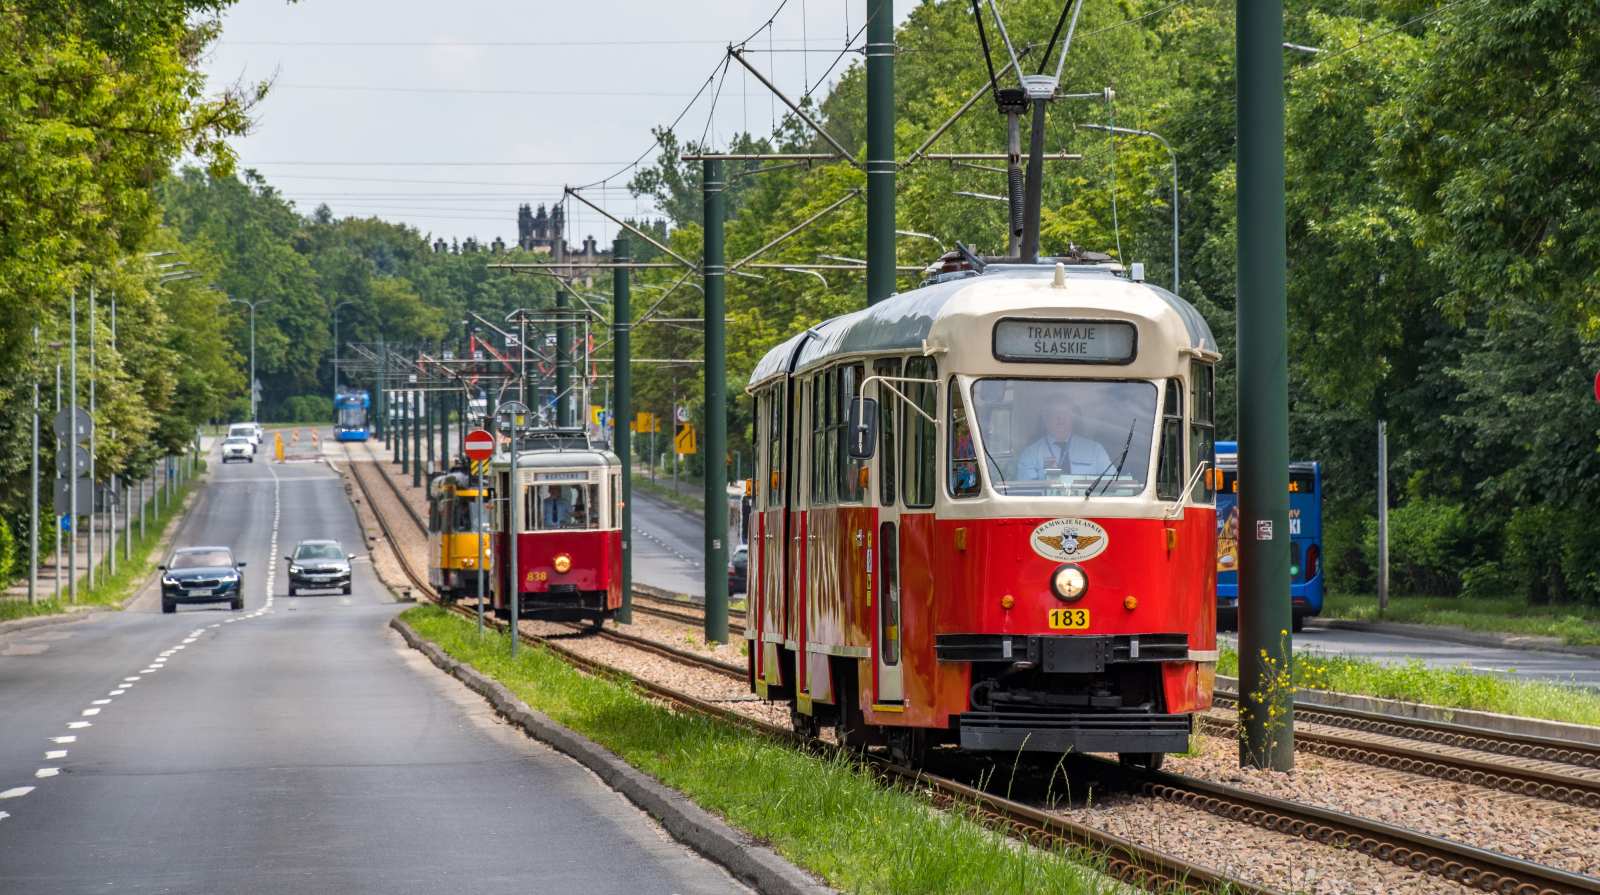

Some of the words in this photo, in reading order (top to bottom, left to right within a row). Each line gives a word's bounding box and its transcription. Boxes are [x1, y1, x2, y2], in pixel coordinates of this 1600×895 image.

[1027, 326, 1096, 340] TRAMWAJE
[1034, 341, 1088, 355] ŚLĄSKIE
[527, 571, 547, 582] 838
[1051, 610, 1086, 626] 183
